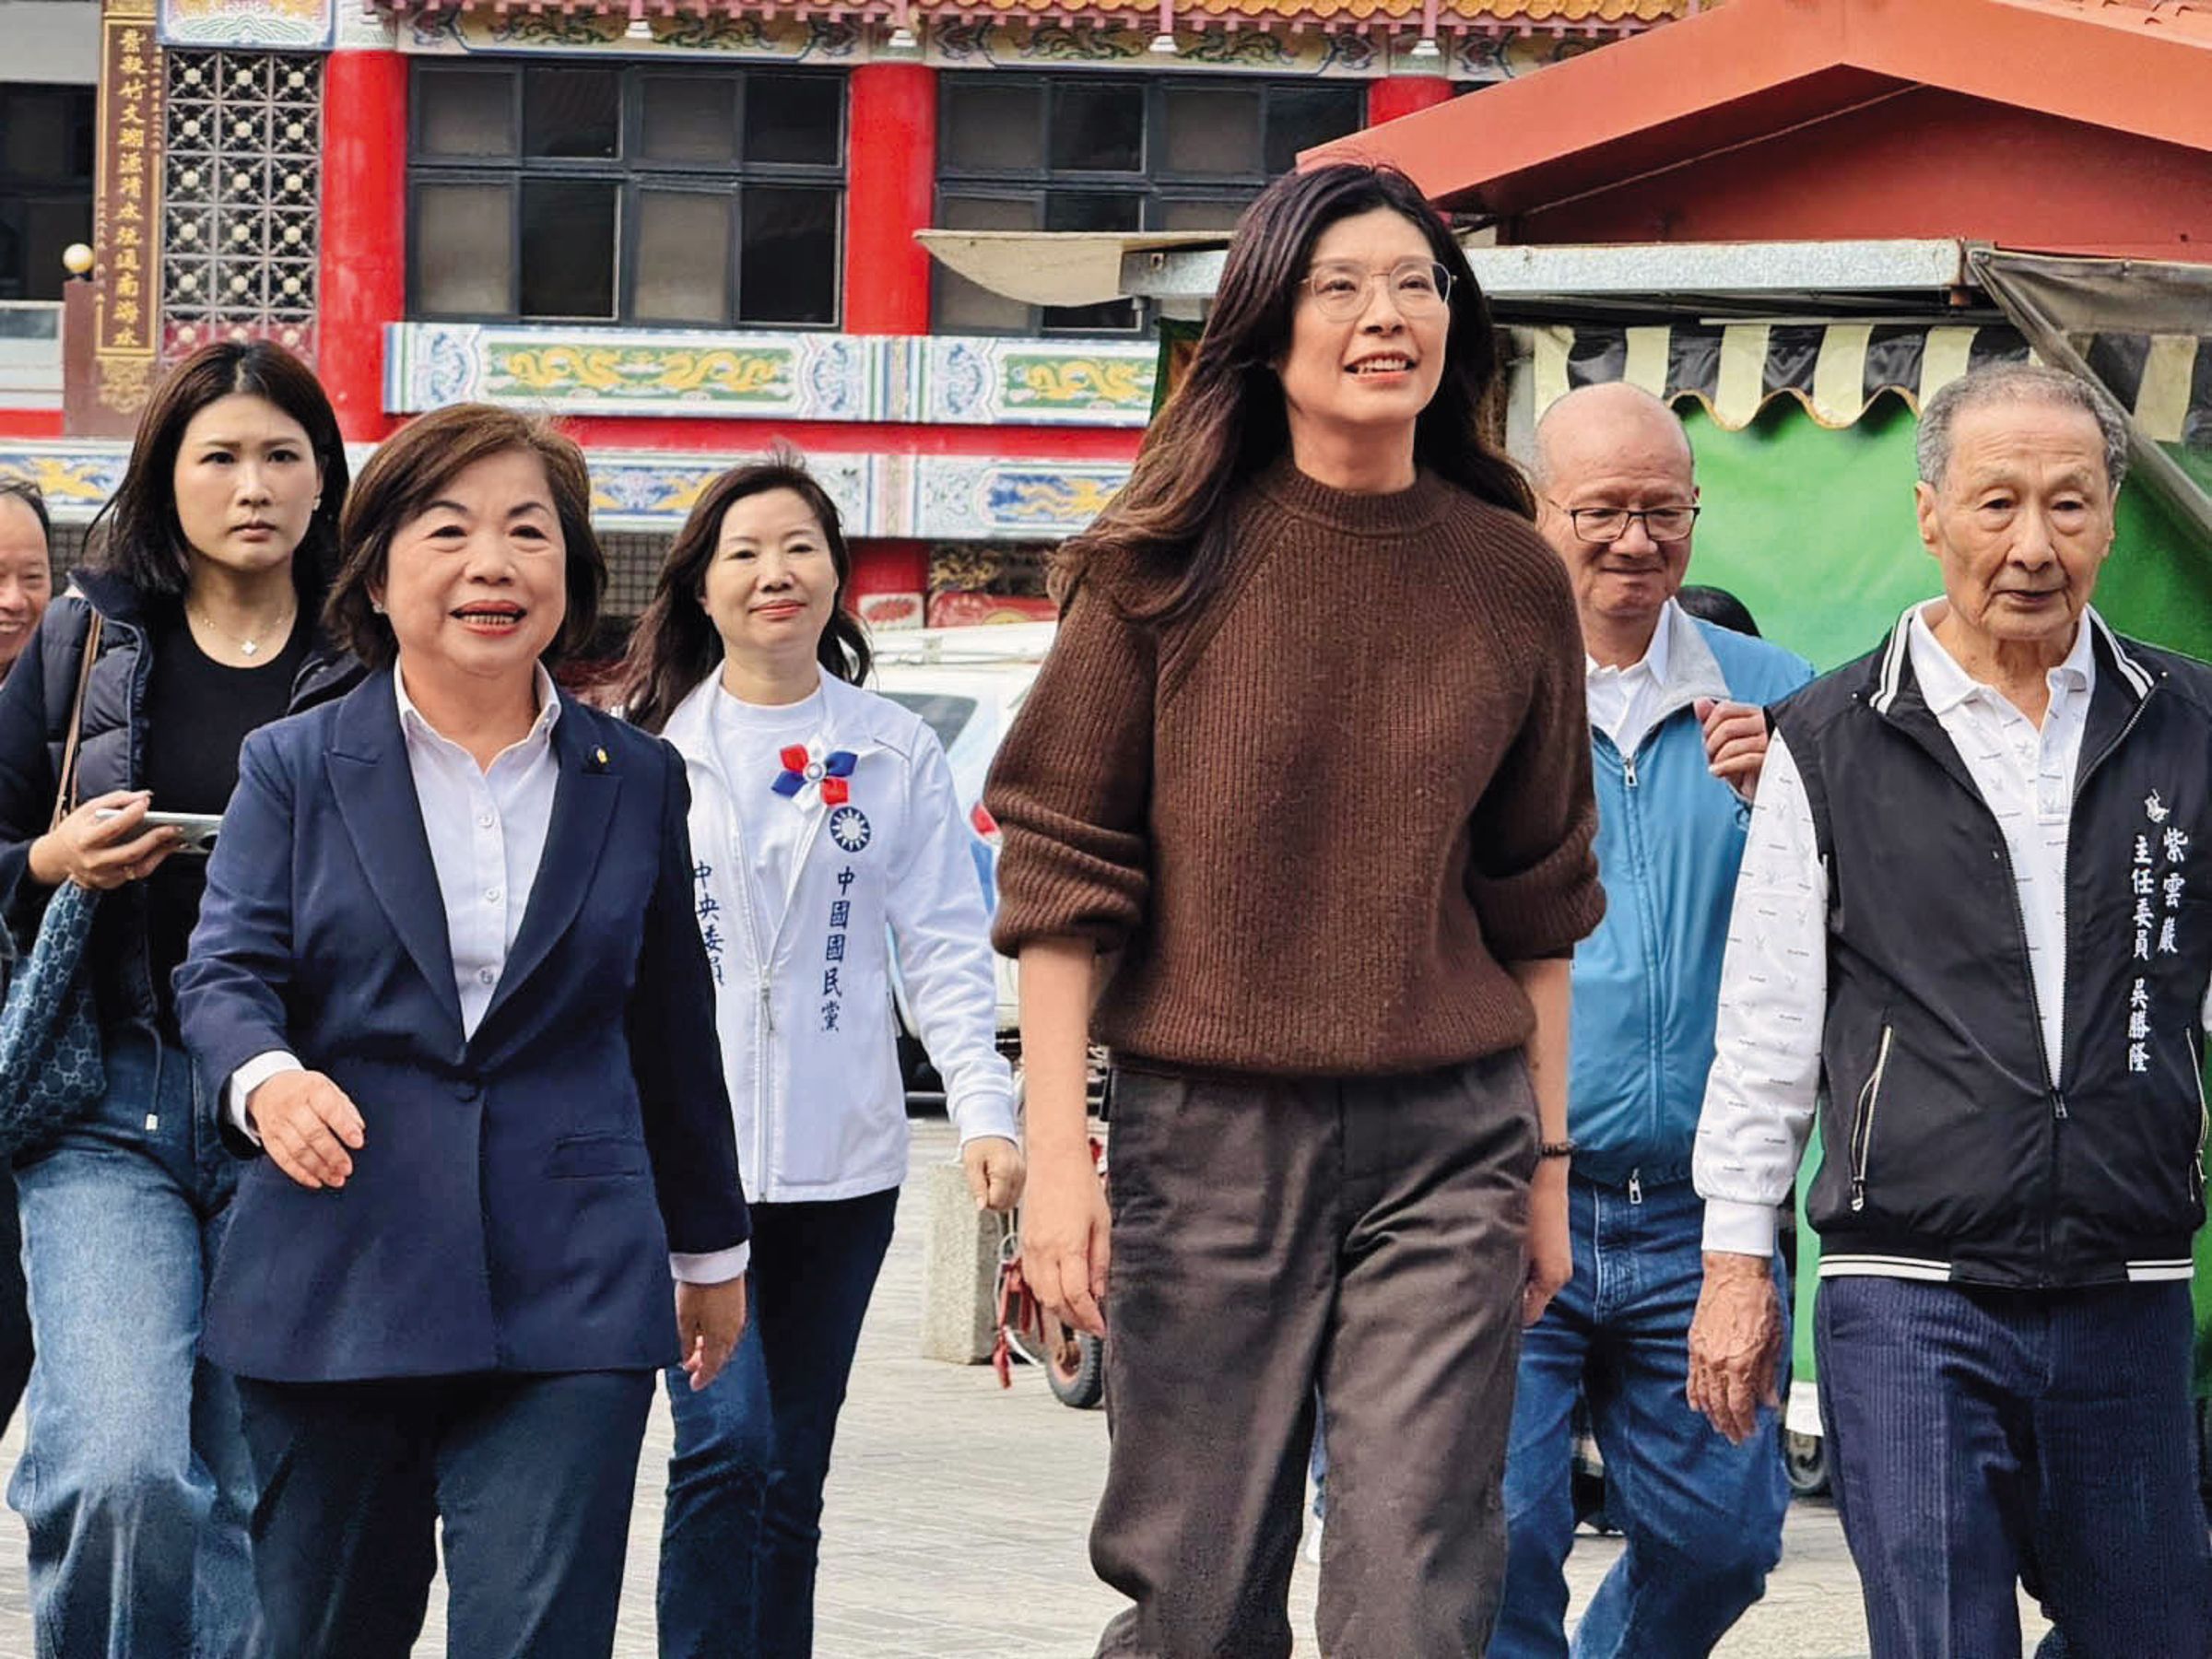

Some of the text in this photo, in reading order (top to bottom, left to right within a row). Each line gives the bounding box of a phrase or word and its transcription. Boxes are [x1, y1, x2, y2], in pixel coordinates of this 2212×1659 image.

[821, 865, 854, 1033] 中國國民黨
[2131, 834, 2155, 961] 主任委員
